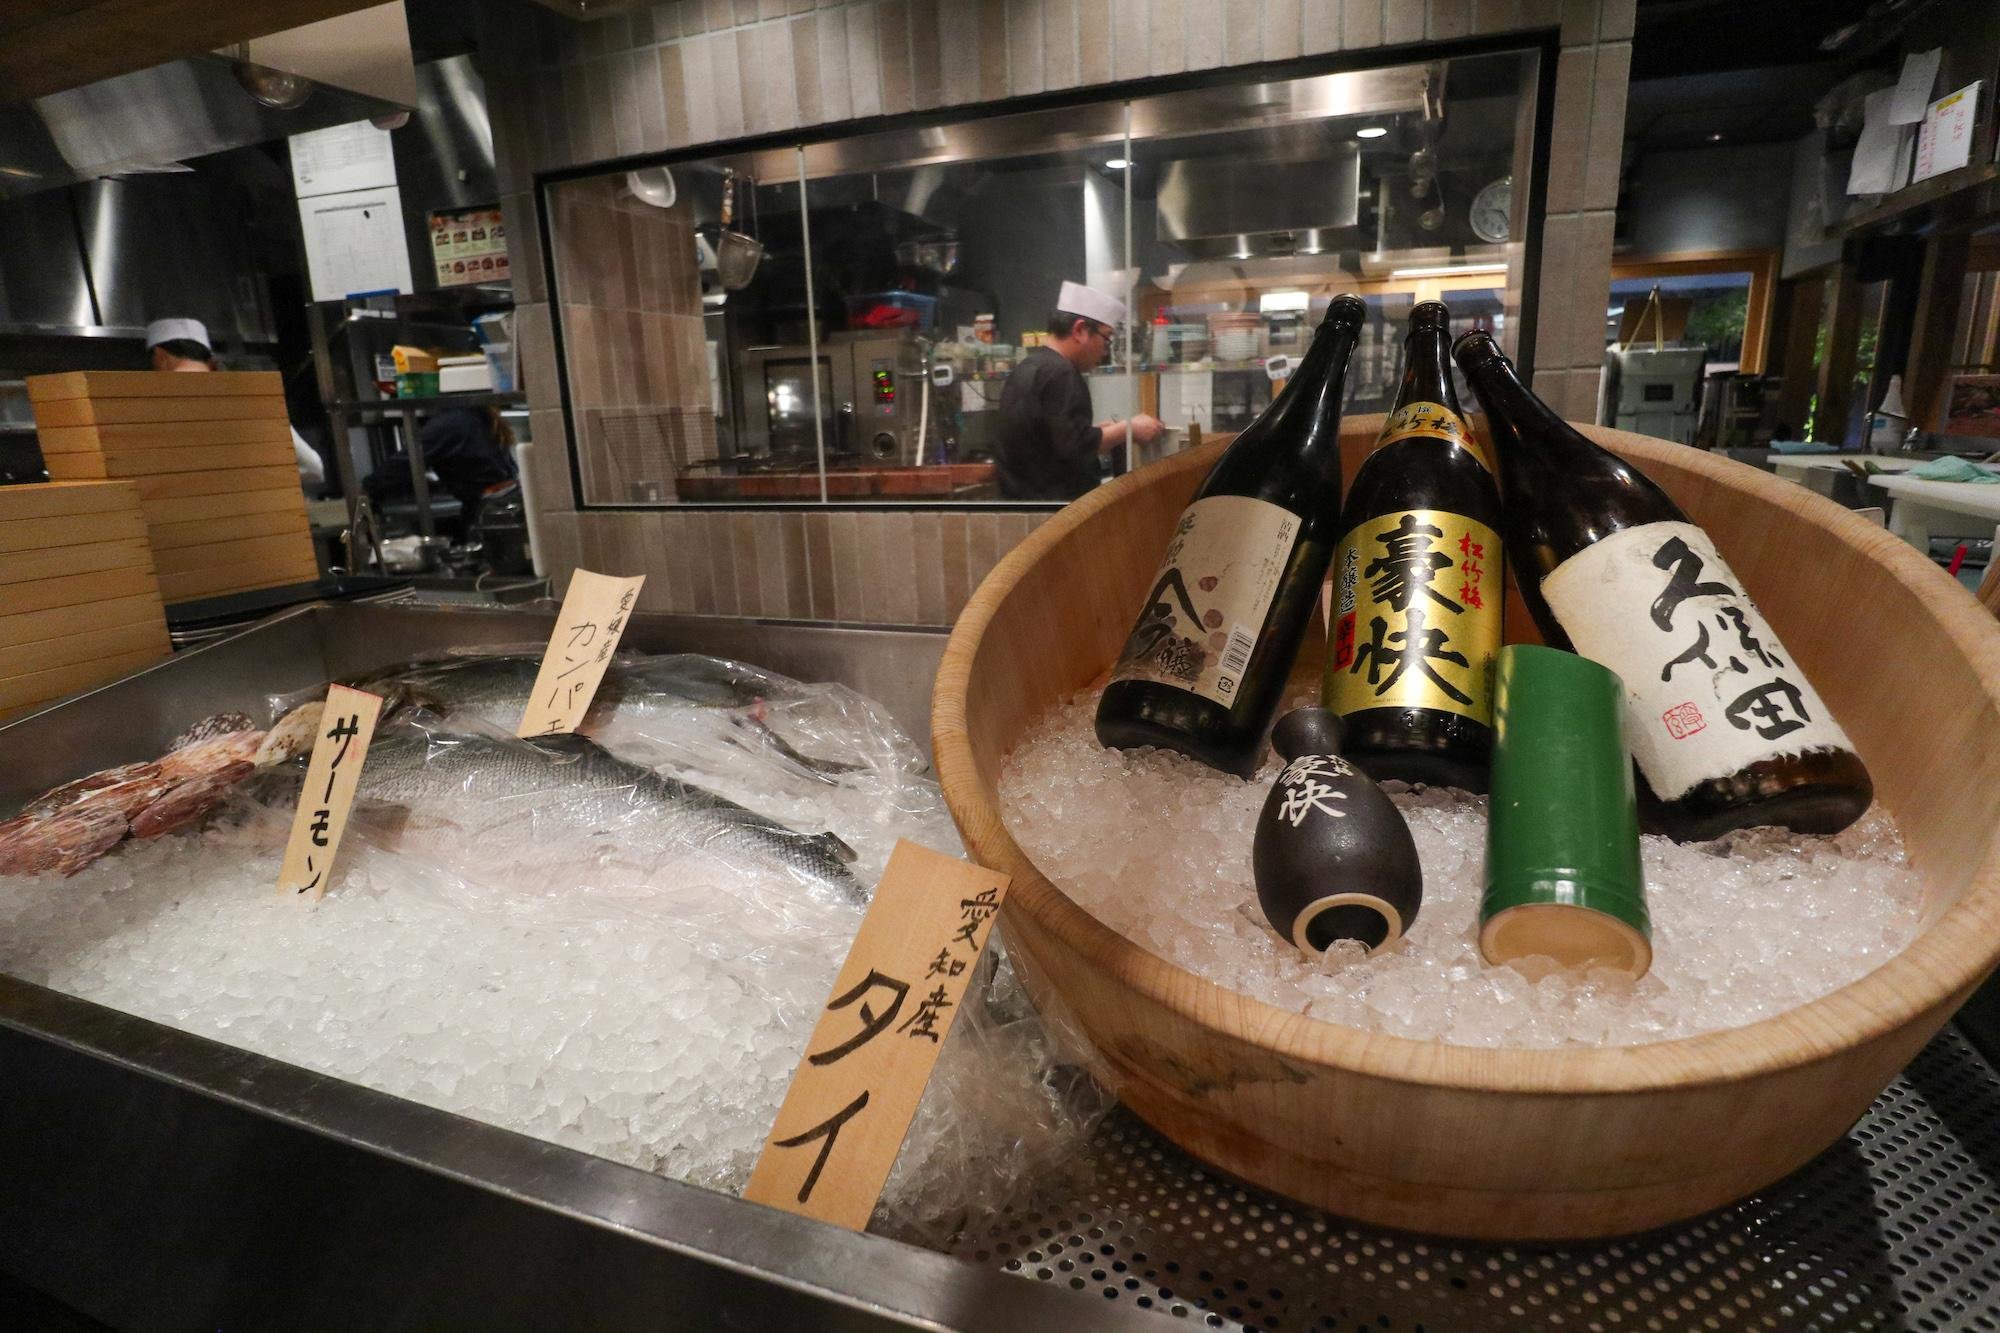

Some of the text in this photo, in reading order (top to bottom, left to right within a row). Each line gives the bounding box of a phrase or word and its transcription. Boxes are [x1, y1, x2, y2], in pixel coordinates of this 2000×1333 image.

[1338, 547, 1360, 616] 本醸造
[1350, 514, 1473, 705] 豪快
[1458, 531, 1485, 610] 松竹梅
[1650, 536, 1811, 741] 久保田
[297, 714, 359, 894] サーモン
[896, 887, 999, 1043] 愛知産
[773, 967, 911, 1204] タイ
